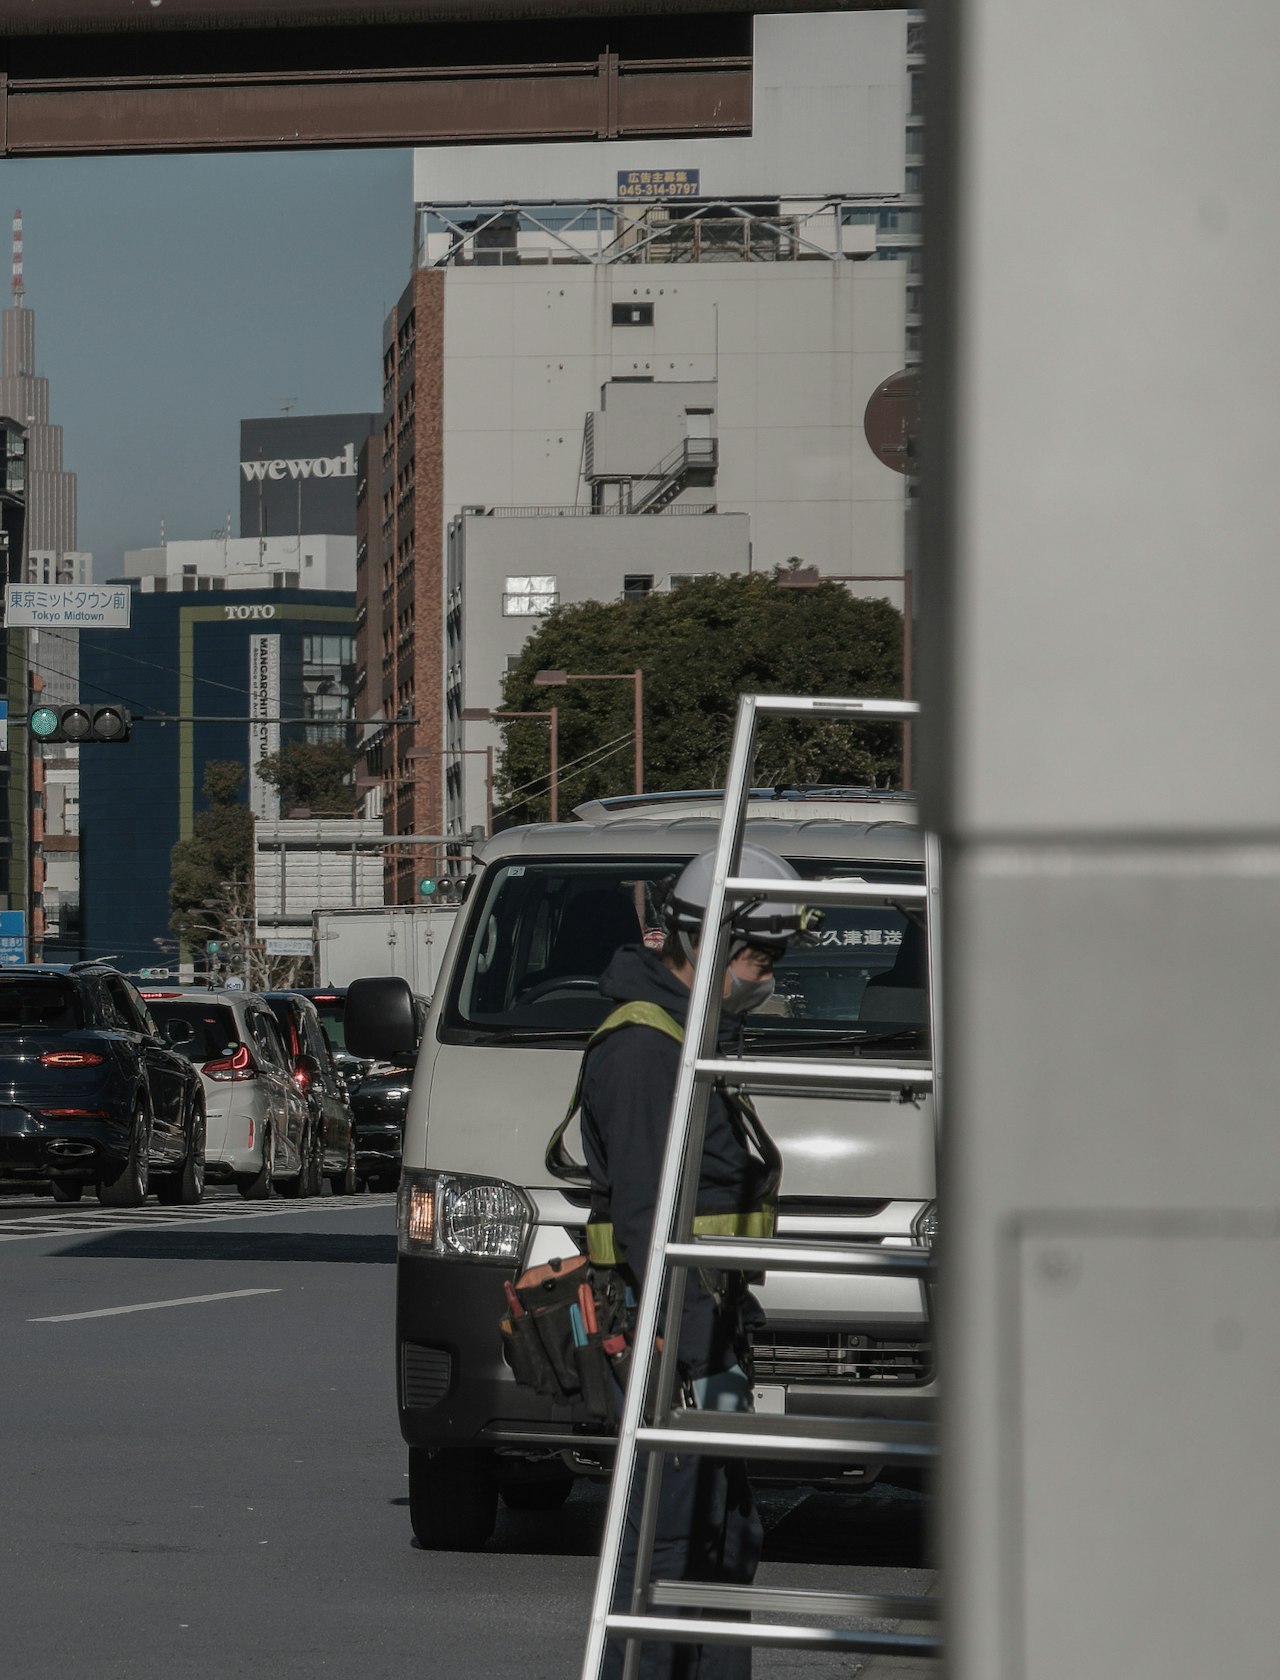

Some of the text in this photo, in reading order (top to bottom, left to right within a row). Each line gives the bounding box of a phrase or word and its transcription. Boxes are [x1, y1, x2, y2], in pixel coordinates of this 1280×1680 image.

[628, 171, 688, 184] 広告主募集
[619, 184, 697, 196] 045-314-9797
[10, 592, 125, 609] 東京ミッドタウン前
[32, 610, 104, 622] Tokyo Midtown
[225, 605, 275, 620] TOTO
